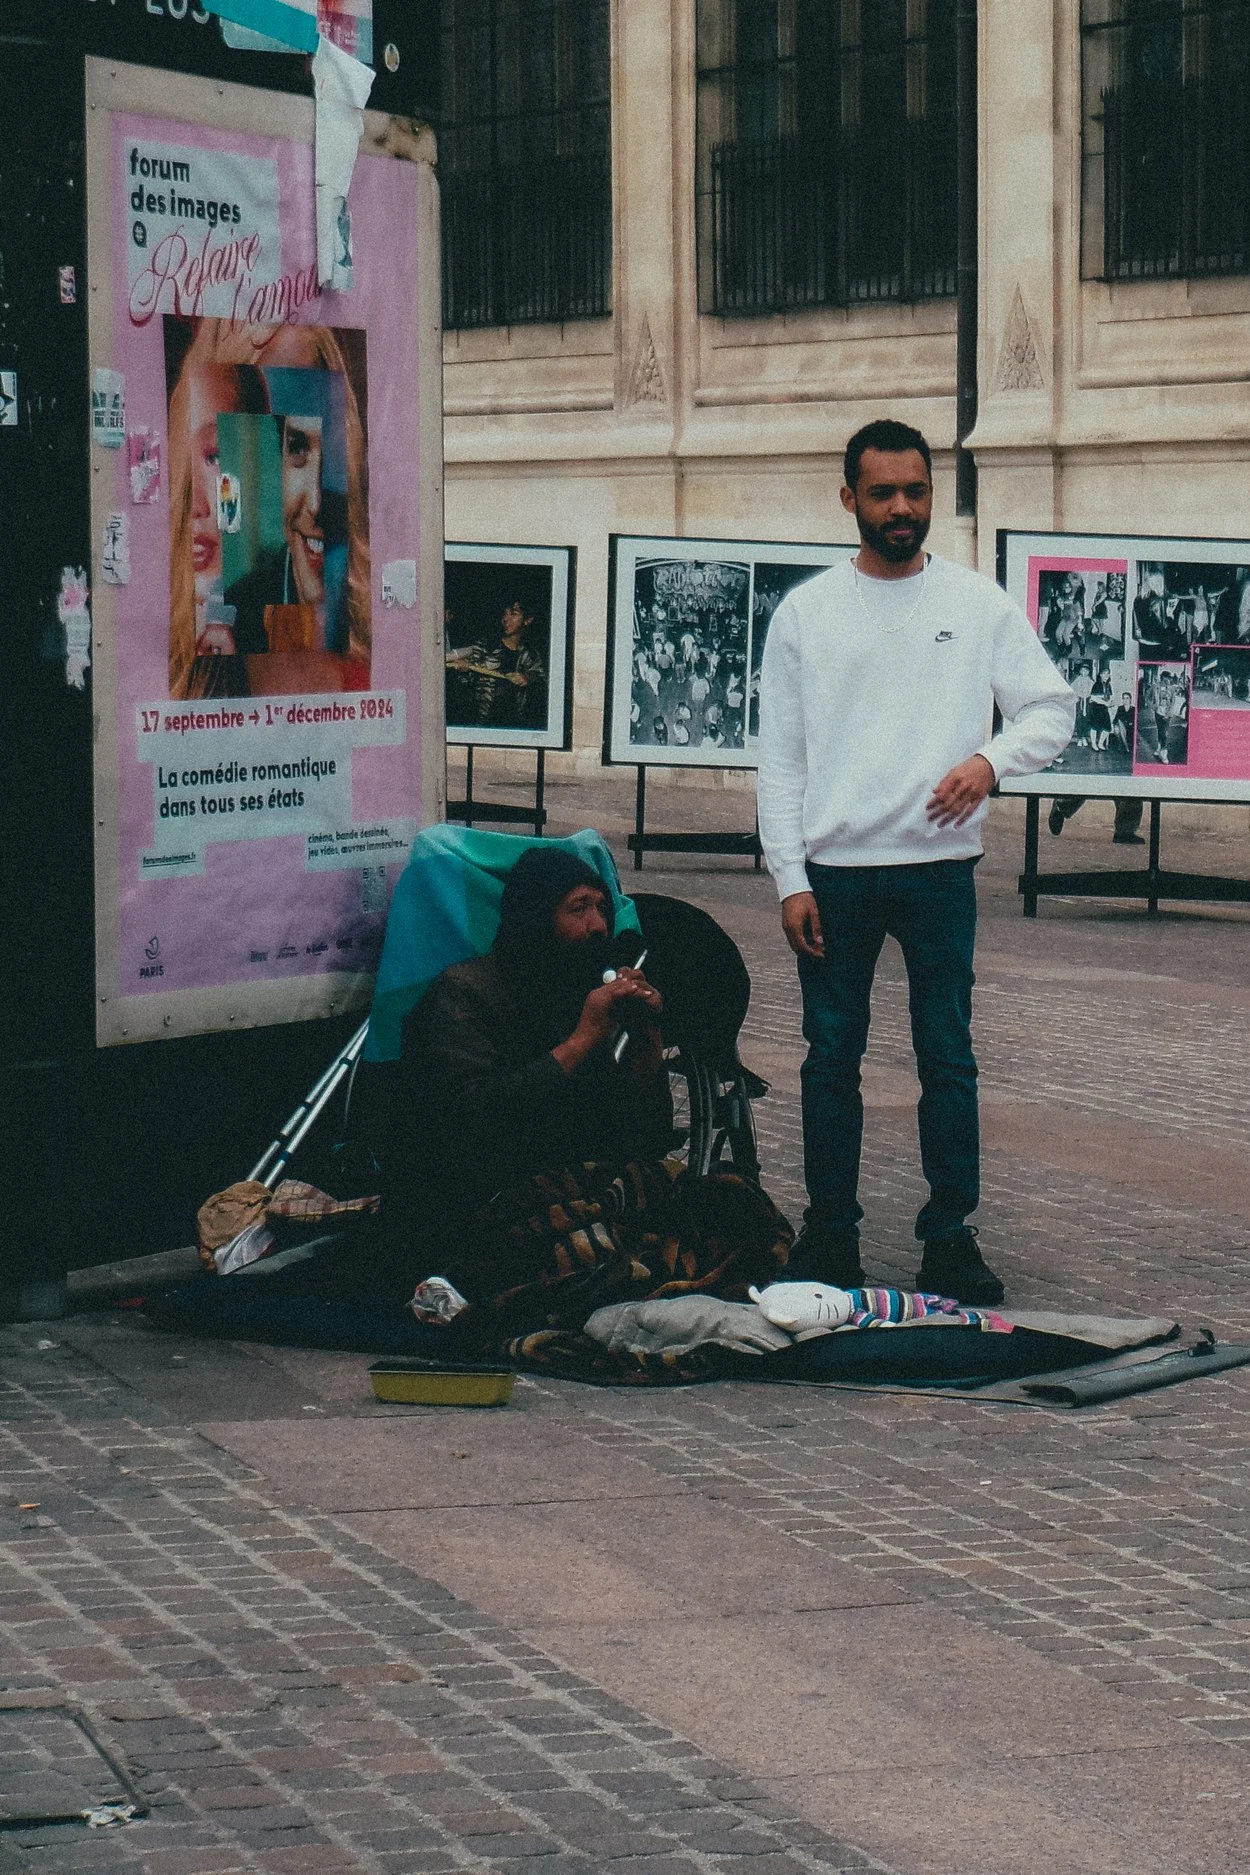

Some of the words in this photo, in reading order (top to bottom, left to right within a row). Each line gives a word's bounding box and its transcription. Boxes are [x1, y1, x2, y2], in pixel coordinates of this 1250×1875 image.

[130, 147, 190, 183] forum
[131, 184, 166, 215] des
[170, 188, 242, 228] images
[129, 224, 263, 333] Refaire
[141, 710, 160, 732] 17
[165, 707, 245, 736] septembre
[287, 702, 356, 724] décembre
[360, 698, 393, 720] 2024
[159, 766, 178, 788] La
[182, 761, 248, 786] comédie
[252, 756, 337, 781] romantique
[160, 796, 196, 818] dans
[201, 794, 235, 814] tous
[240, 793, 264, 811] ses
[268, 788, 305, 809] états
[336, 830, 358, 841] bande
[139, 965, 165, 979] PARIS
